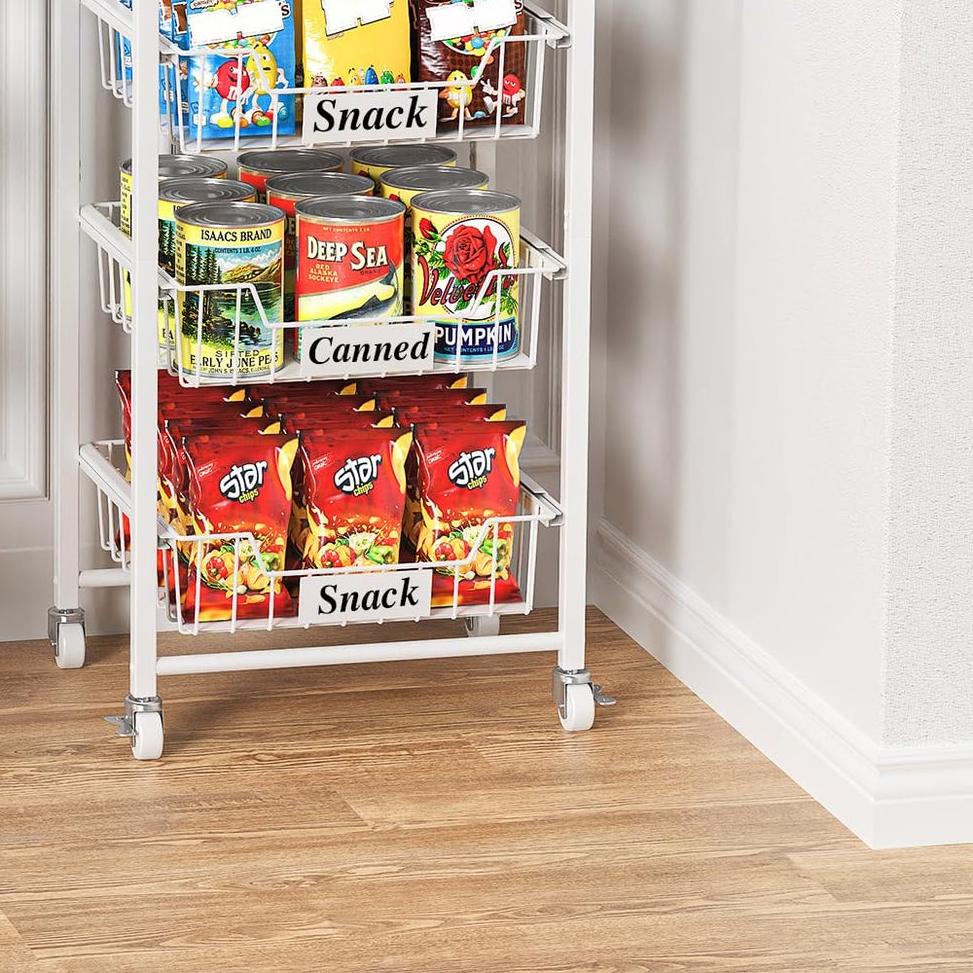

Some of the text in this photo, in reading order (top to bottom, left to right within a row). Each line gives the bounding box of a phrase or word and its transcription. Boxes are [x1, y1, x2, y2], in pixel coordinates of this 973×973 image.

[313, 94, 427, 133] Snack
[200, 228, 272, 242] ISAACS BRAND
[307, 235, 388, 271] DEEP SEA
[308, 274, 339, 283] SOCKEYE
[309, 268, 338, 277] ALASKA
[435, 322, 512, 346] PUMPKIN
[308, 330, 430, 365] Canned
[190, 354, 223, 368] ERLY
[353, 482, 374, 497] chips
[467, 475, 488, 490] chips
[238, 488, 259, 504] chips
[317, 577, 420, 615] Snack
